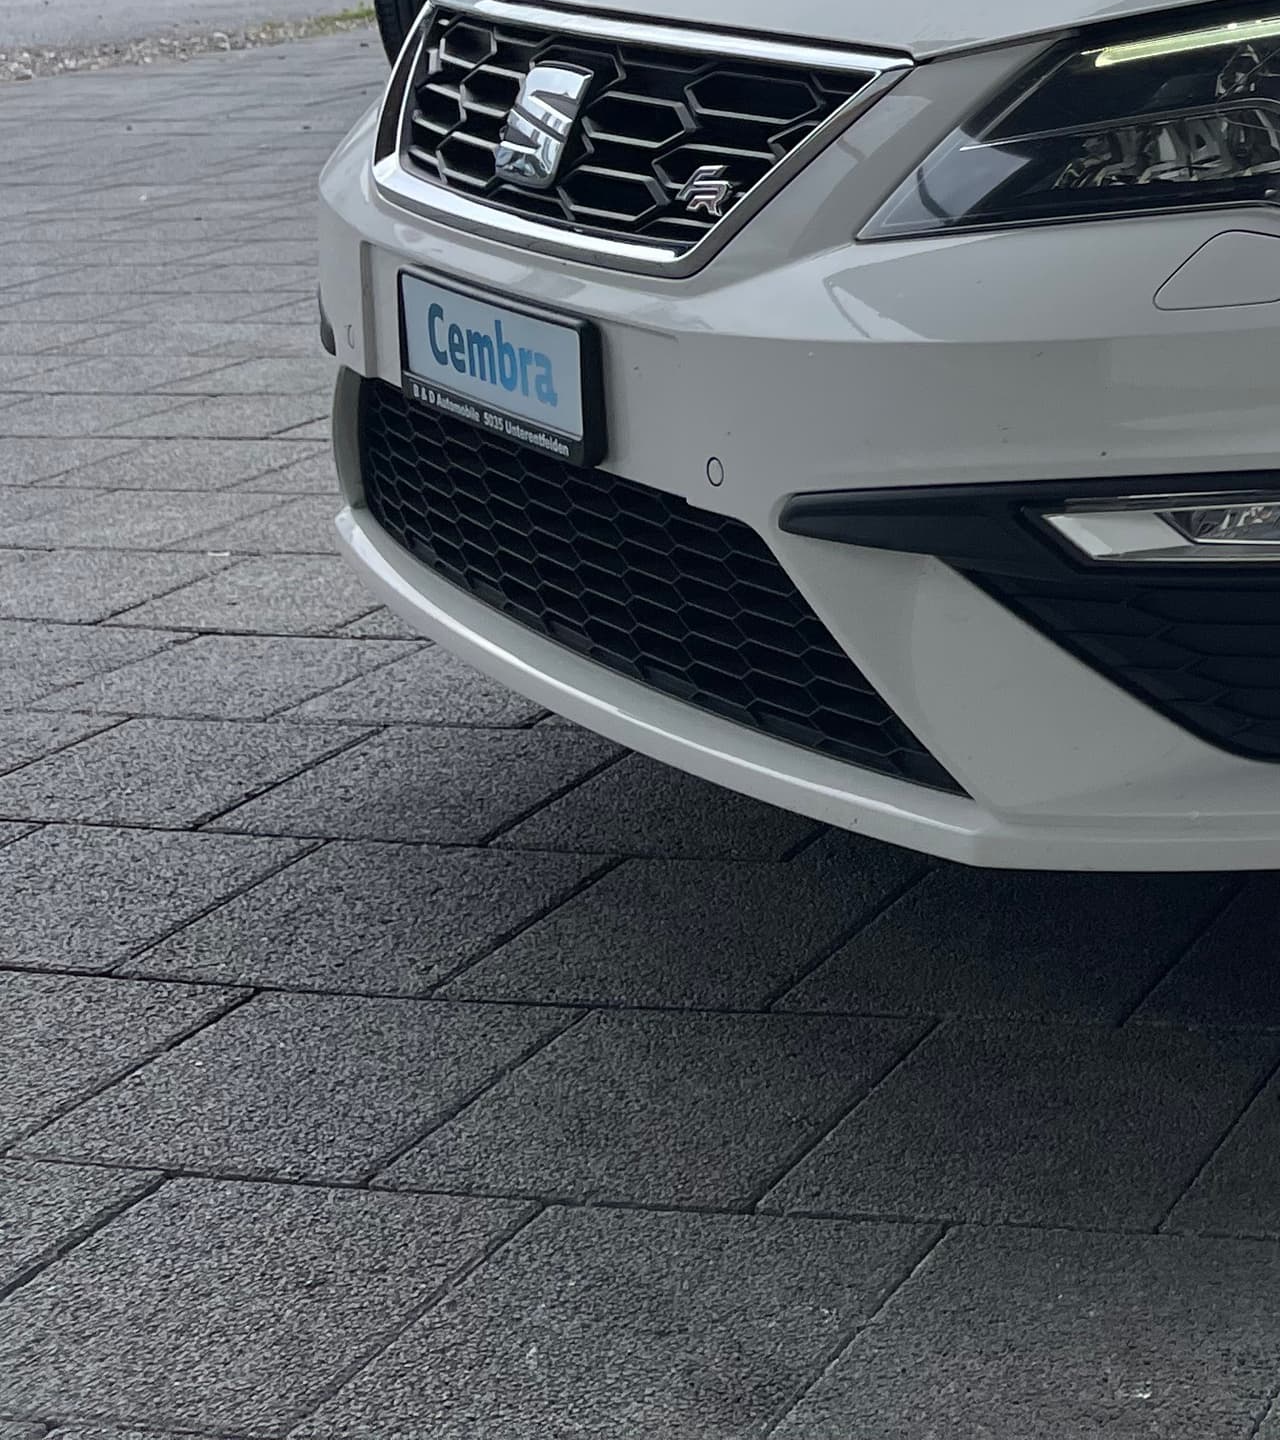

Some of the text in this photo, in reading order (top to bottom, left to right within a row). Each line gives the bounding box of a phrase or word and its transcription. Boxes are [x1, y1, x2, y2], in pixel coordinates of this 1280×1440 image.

[675, 165, 732, 216] FR
[428, 303, 558, 407] Cembra
[436, 393, 480, 422] Automobile
